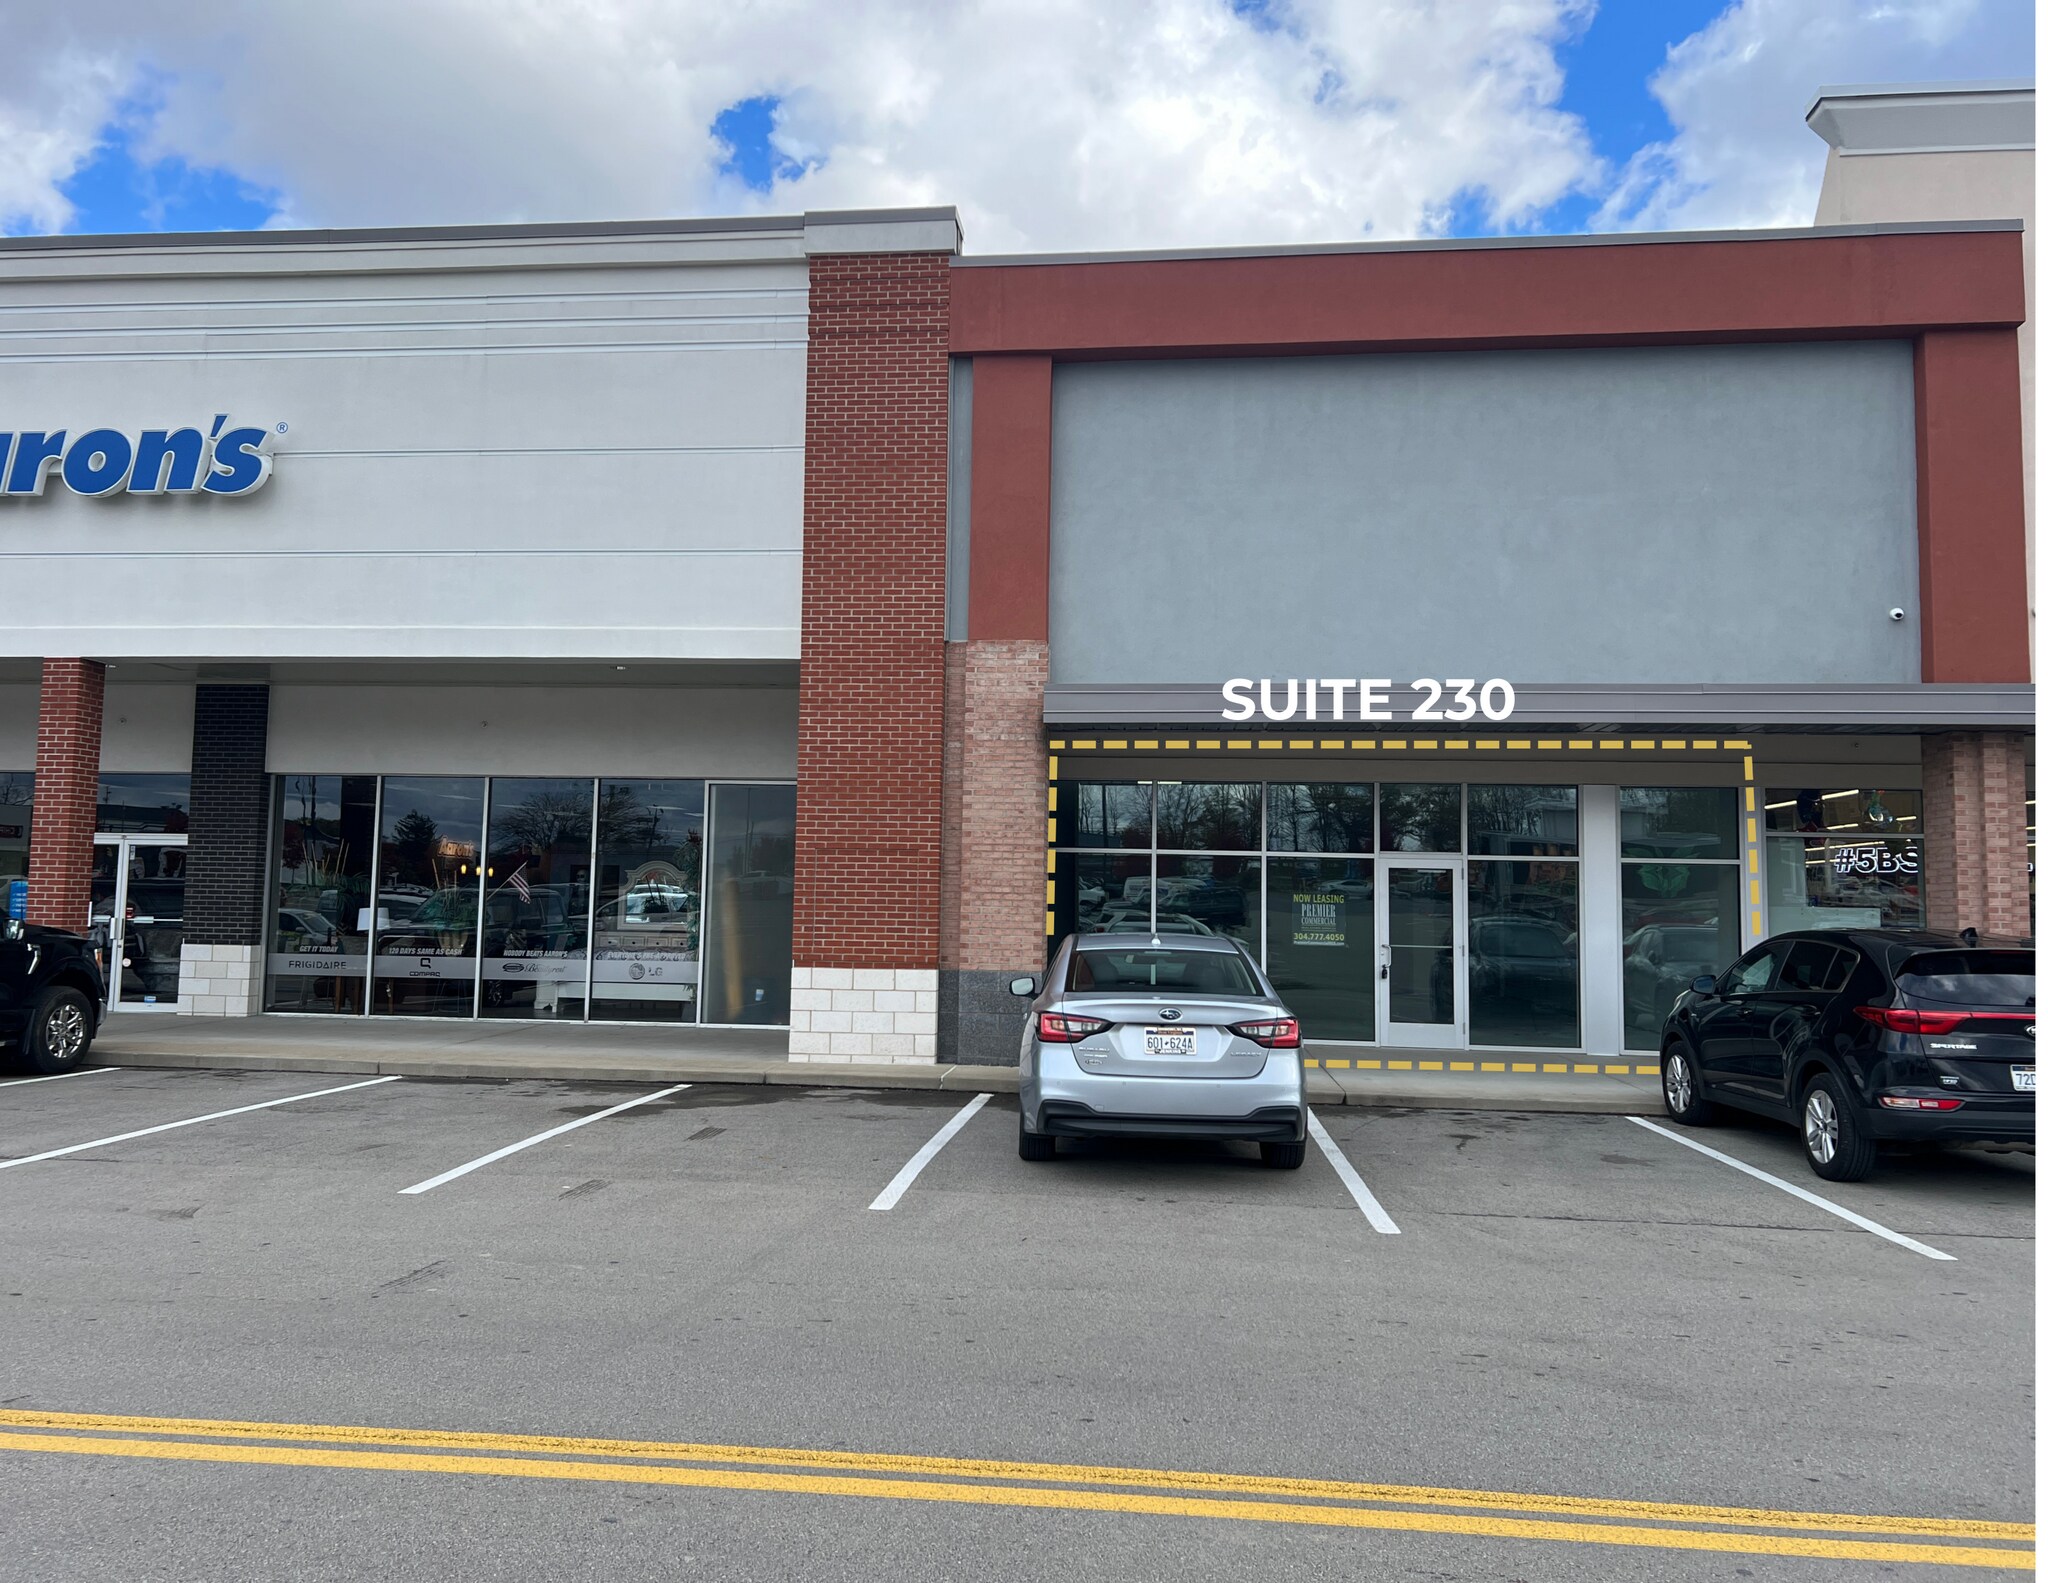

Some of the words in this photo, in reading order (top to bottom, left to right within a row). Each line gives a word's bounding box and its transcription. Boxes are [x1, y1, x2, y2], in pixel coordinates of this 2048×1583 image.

[0, 413, 272, 496] ron's
[1293, 894, 1311, 903] NOW
[1313, 895, 1345, 903] LEASING
[1301, 904, 1336, 917] PREMIER
[1301, 917, 1336, 925] COMMERCIAL
[1293, 933, 1345, 941] 304.777.4050
[503, 949, 526, 957] NOBODY
[288, 960, 347, 969] FRIGIDAIRE
